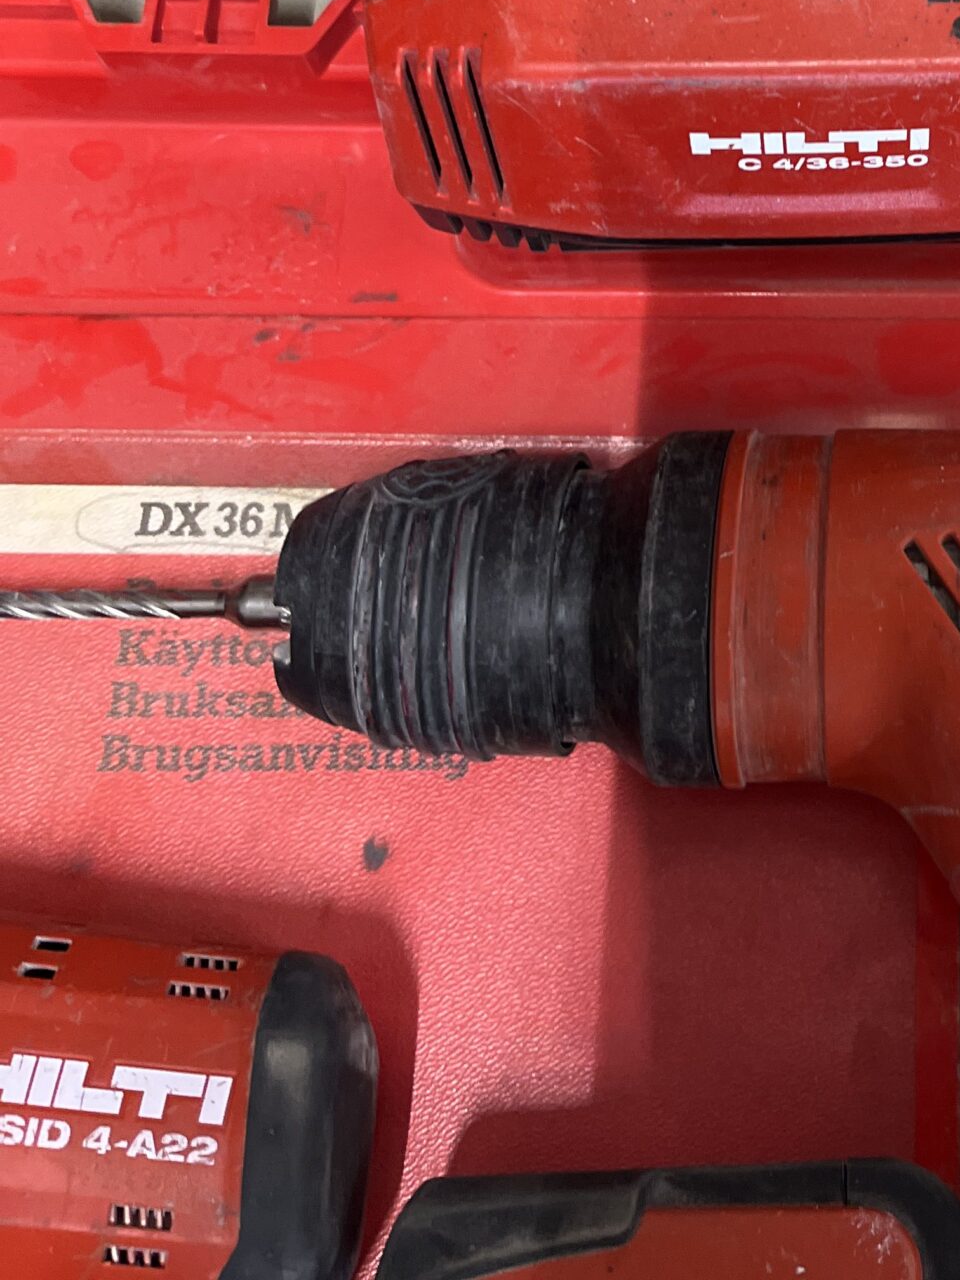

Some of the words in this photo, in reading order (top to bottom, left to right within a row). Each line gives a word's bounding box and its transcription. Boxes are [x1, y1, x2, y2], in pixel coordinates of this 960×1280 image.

[689, 128, 930, 155] HILTI
[737, 157, 762, 171] C
[772, 154, 930, 171] 4/36-350
[0, 1113, 71, 1150] SID
[82, 1124, 219, 1166] 4-A22
